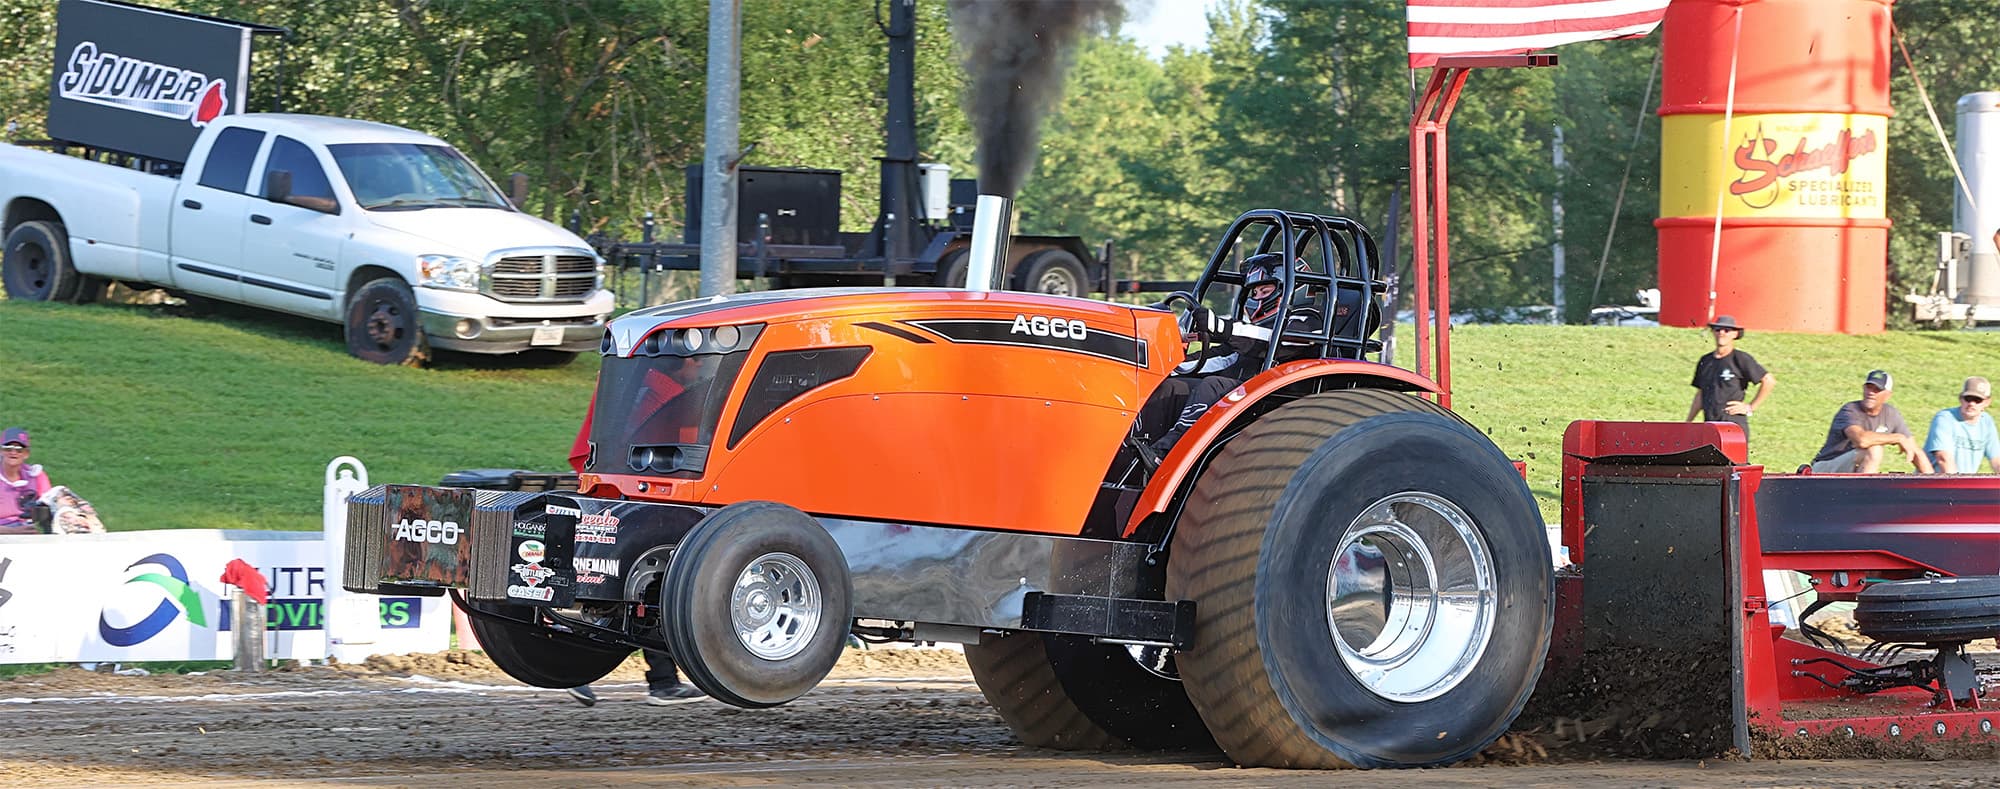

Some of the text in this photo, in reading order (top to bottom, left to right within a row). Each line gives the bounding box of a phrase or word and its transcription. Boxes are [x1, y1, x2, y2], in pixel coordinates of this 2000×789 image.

[1010, 315, 1087, 340] AGCO
[395, 518, 459, 545] AGCO
[575, 525, 616, 533] MPLEMENT
[573, 558, 619, 577] RNEMANN
[509, 587, 541, 598] CASE
